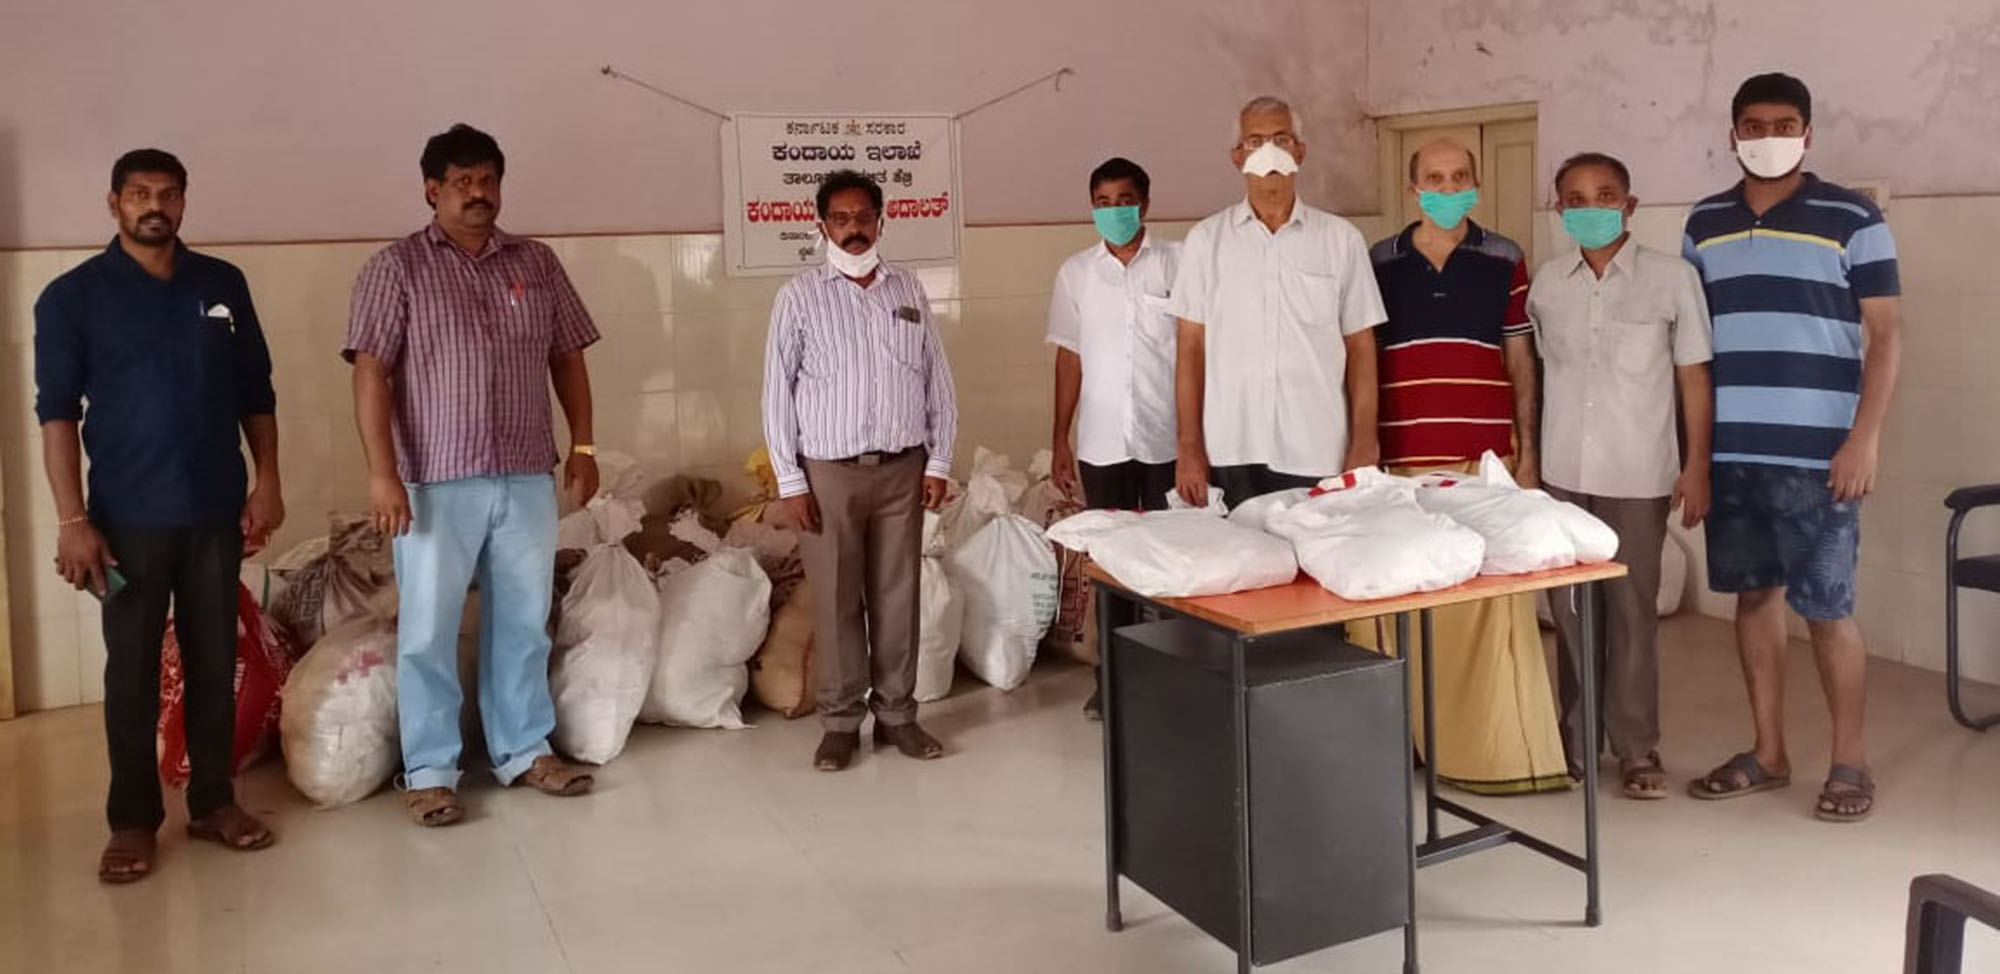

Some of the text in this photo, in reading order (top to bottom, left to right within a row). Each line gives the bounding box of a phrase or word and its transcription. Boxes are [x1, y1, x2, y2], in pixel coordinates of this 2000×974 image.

[772, 140, 921, 161] ಕಂದಾಯ ಇಲಾಖೆ
[747, 192, 949, 222] ಕಂದಾಯ ಅದಾಲತ್
